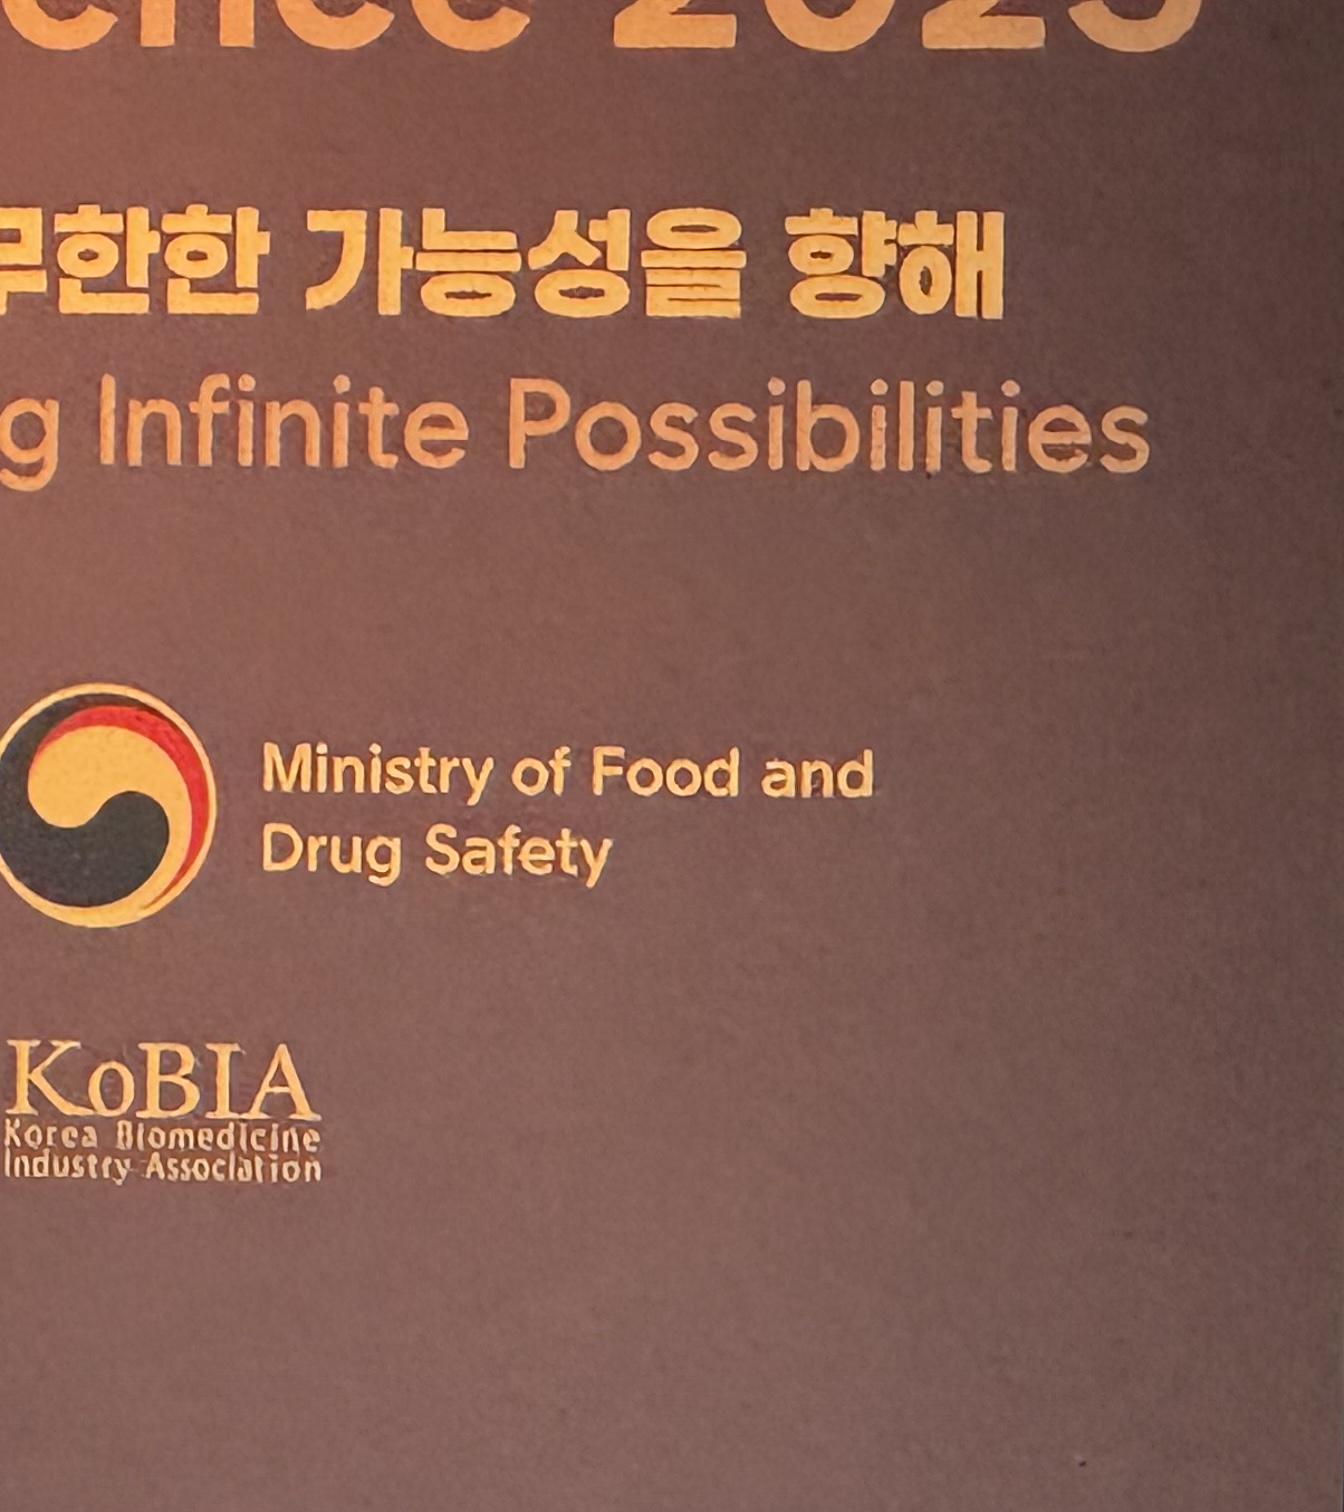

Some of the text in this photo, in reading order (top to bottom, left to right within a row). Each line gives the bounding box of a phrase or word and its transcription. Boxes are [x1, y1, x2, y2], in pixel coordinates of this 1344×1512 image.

[305, 207, 747, 319] 가능성을
[784, 207, 1005, 320] 향해
[99, 373, 470, 469] Infinite
[509, 377, 1150, 474] Possibilities
[263, 742, 875, 806] Ministry of Food and
[262, 822, 613, 889] Drug Safety
[4, 1039, 323, 1122] KoBIA
[4, 1118, 322, 1153] Korea Biomedicine
[4, 1148, 322, 1186] Industry Association
